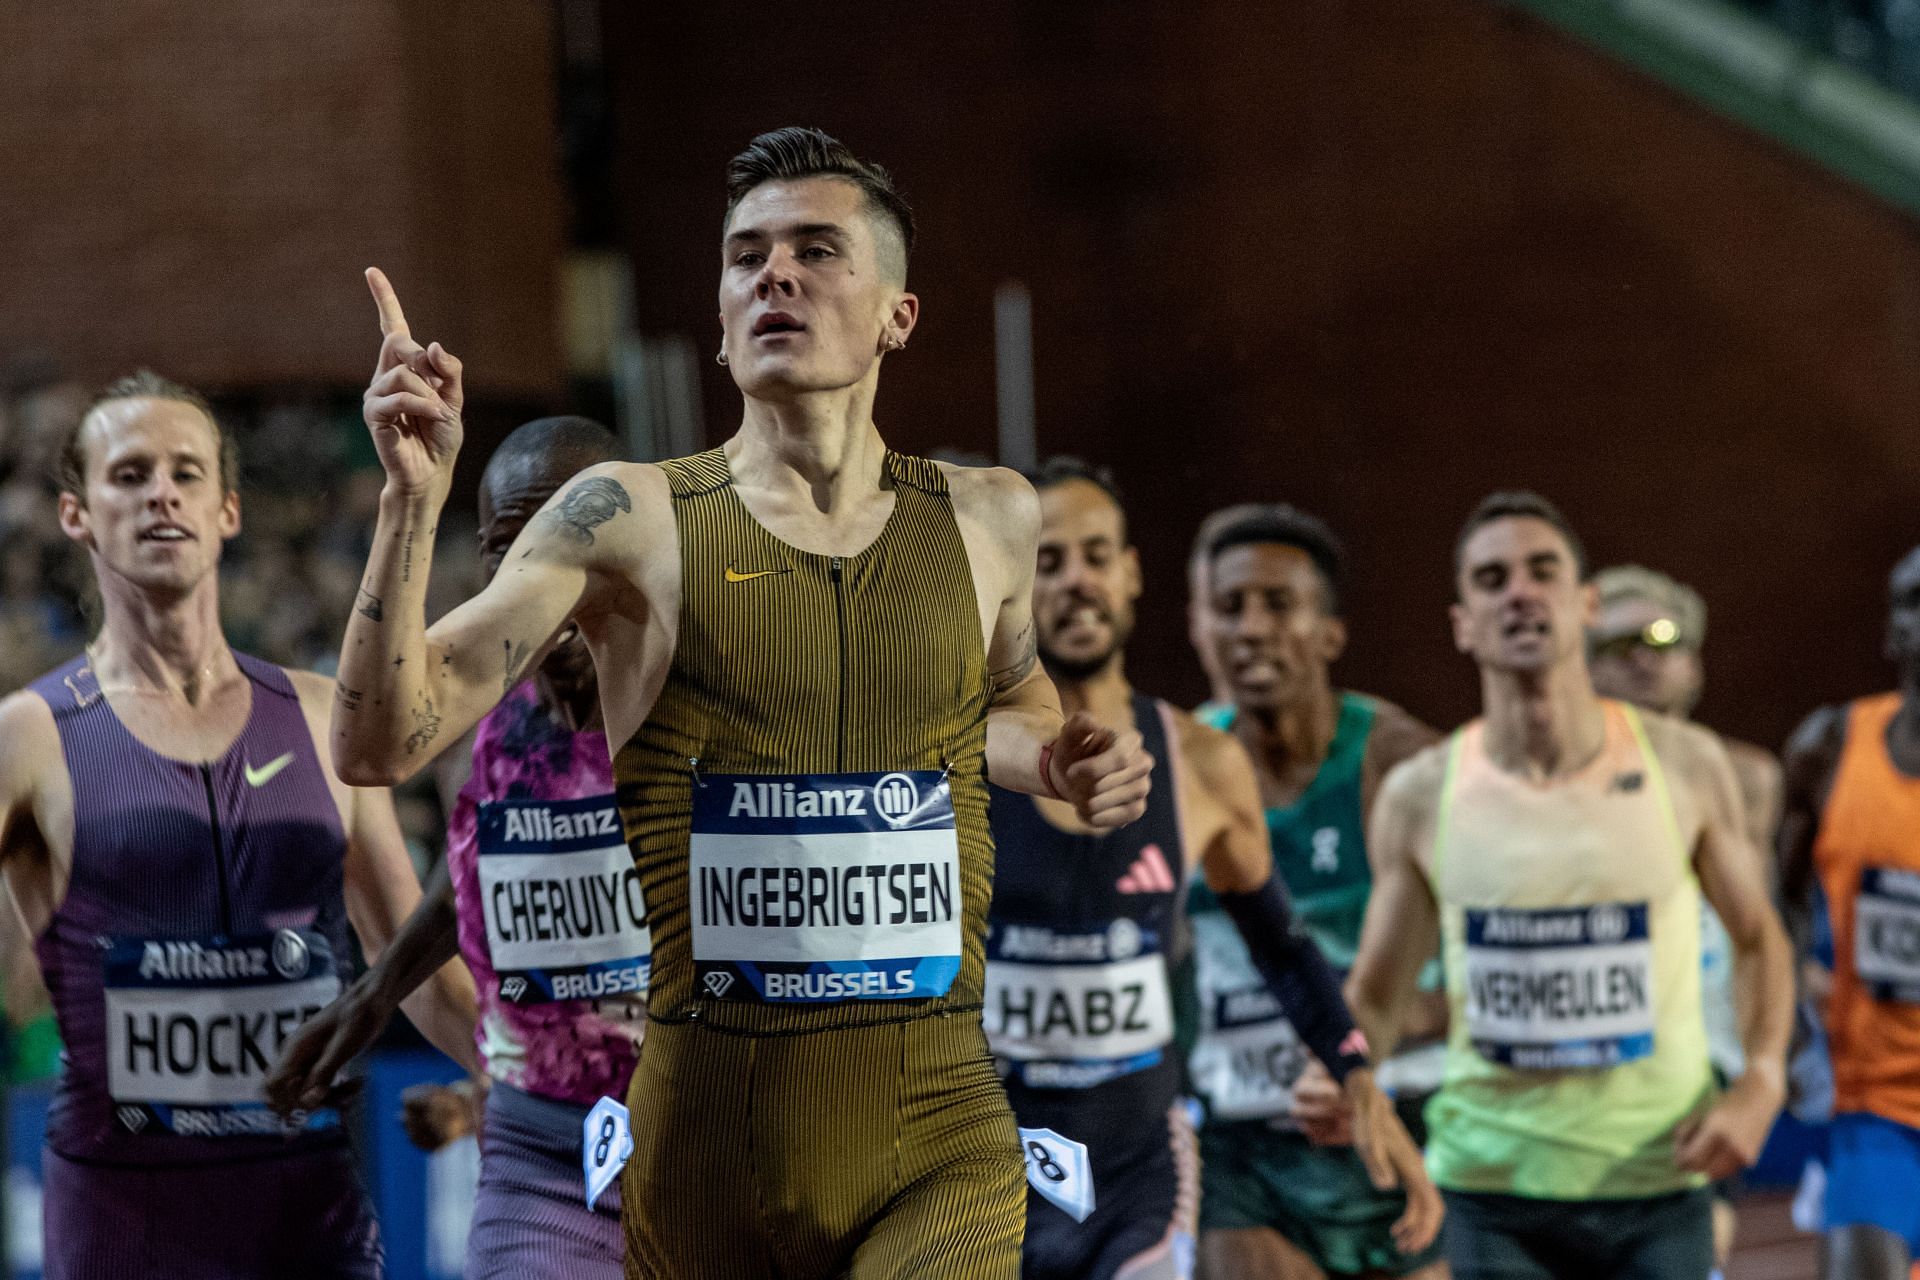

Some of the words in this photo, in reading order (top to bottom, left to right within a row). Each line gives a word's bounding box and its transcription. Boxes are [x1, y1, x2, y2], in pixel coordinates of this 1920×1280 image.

[728, 781, 868, 818] Allianz
[503, 807, 620, 842] Allianz
[699, 862, 952, 927] INGEBRIGTSEN
[139, 940, 269, 980] Allianz
[764, 969, 915, 998] BRUSSELS
[999, 983, 1150, 1037] HABZ
[124, 1004, 323, 1075] HOCKE
[596, 1115, 615, 1168] 8
[1027, 1141, 1066, 1182] 8
